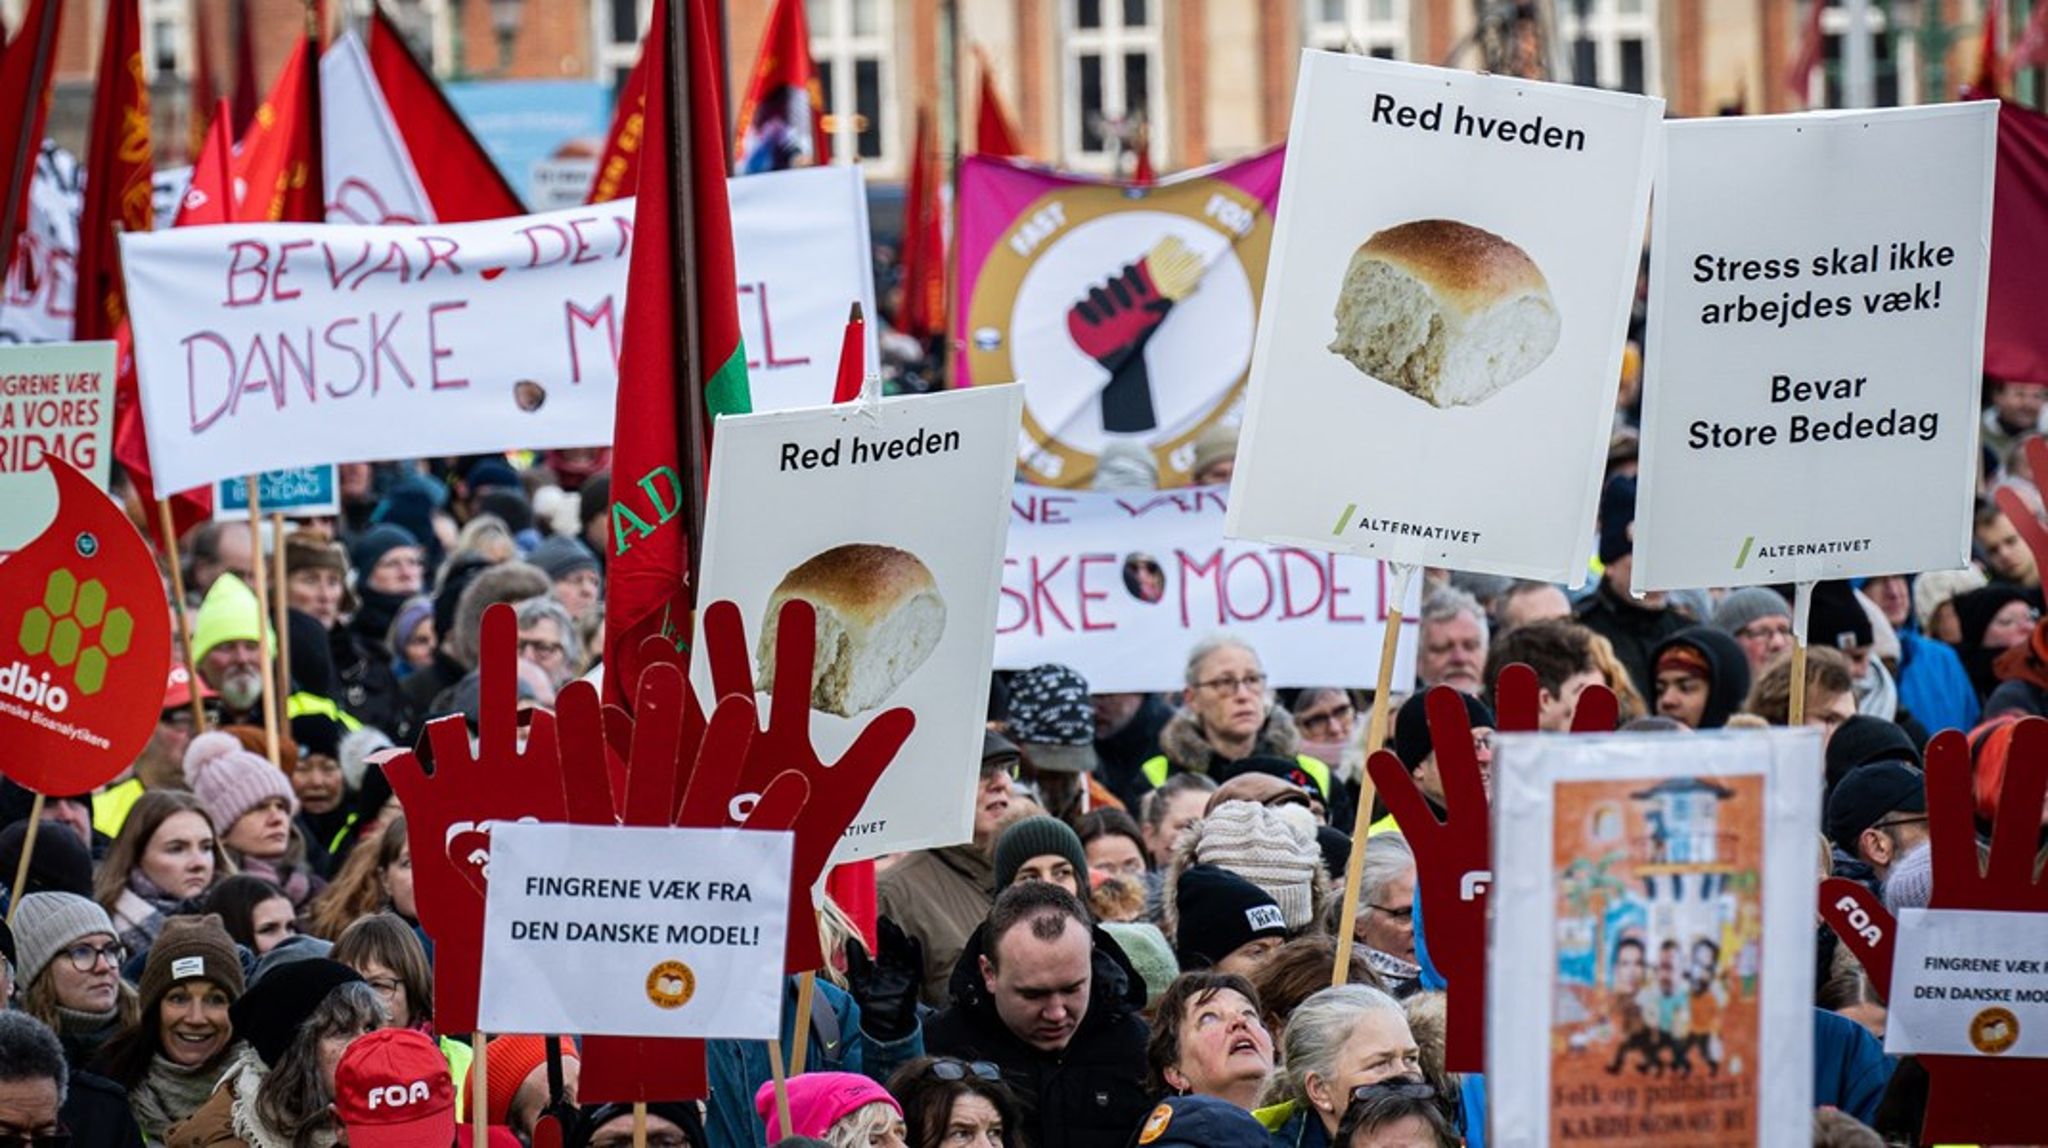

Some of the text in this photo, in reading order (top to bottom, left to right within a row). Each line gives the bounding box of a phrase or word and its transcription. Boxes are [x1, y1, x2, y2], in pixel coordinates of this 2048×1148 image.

[1371, 93, 1586, 151] Red hveden
[222, 235, 462, 308] BEVAR
[1693, 241, 1955, 283] Stress skal ikke
[1701, 280, 1942, 328] arbejdes væk!
[66, 372, 101, 393] VÆK
[180, 300, 470, 435] DANSKE
[1770, 375, 1867, 403] Bevar
[23, 398, 99, 428] VORES
[1688, 408, 1939, 449] Store Bededag
[780, 428, 960, 472] Red hveden
[1359, 517, 1481, 544] ALTERNATIVET
[1758, 539, 1872, 558] ALTERNATIVET
[1173, 547, 1418, 628] MODEL
[0, 661, 69, 713] dbio
[525, 877, 752, 902] FINGRENE VÆK FRA
[511, 921, 759, 946] DEN DANSKE MODEL!
[1835, 896, 1883, 948] FOA
[1924, 957, 2001, 973] FINGRENE
[2005, 960, 2039, 974] VÆK
[1914, 986, 1946, 1000] DEN
[1951, 988, 2012, 1002] DANSKE
[368, 1081, 430, 1110] FOA
